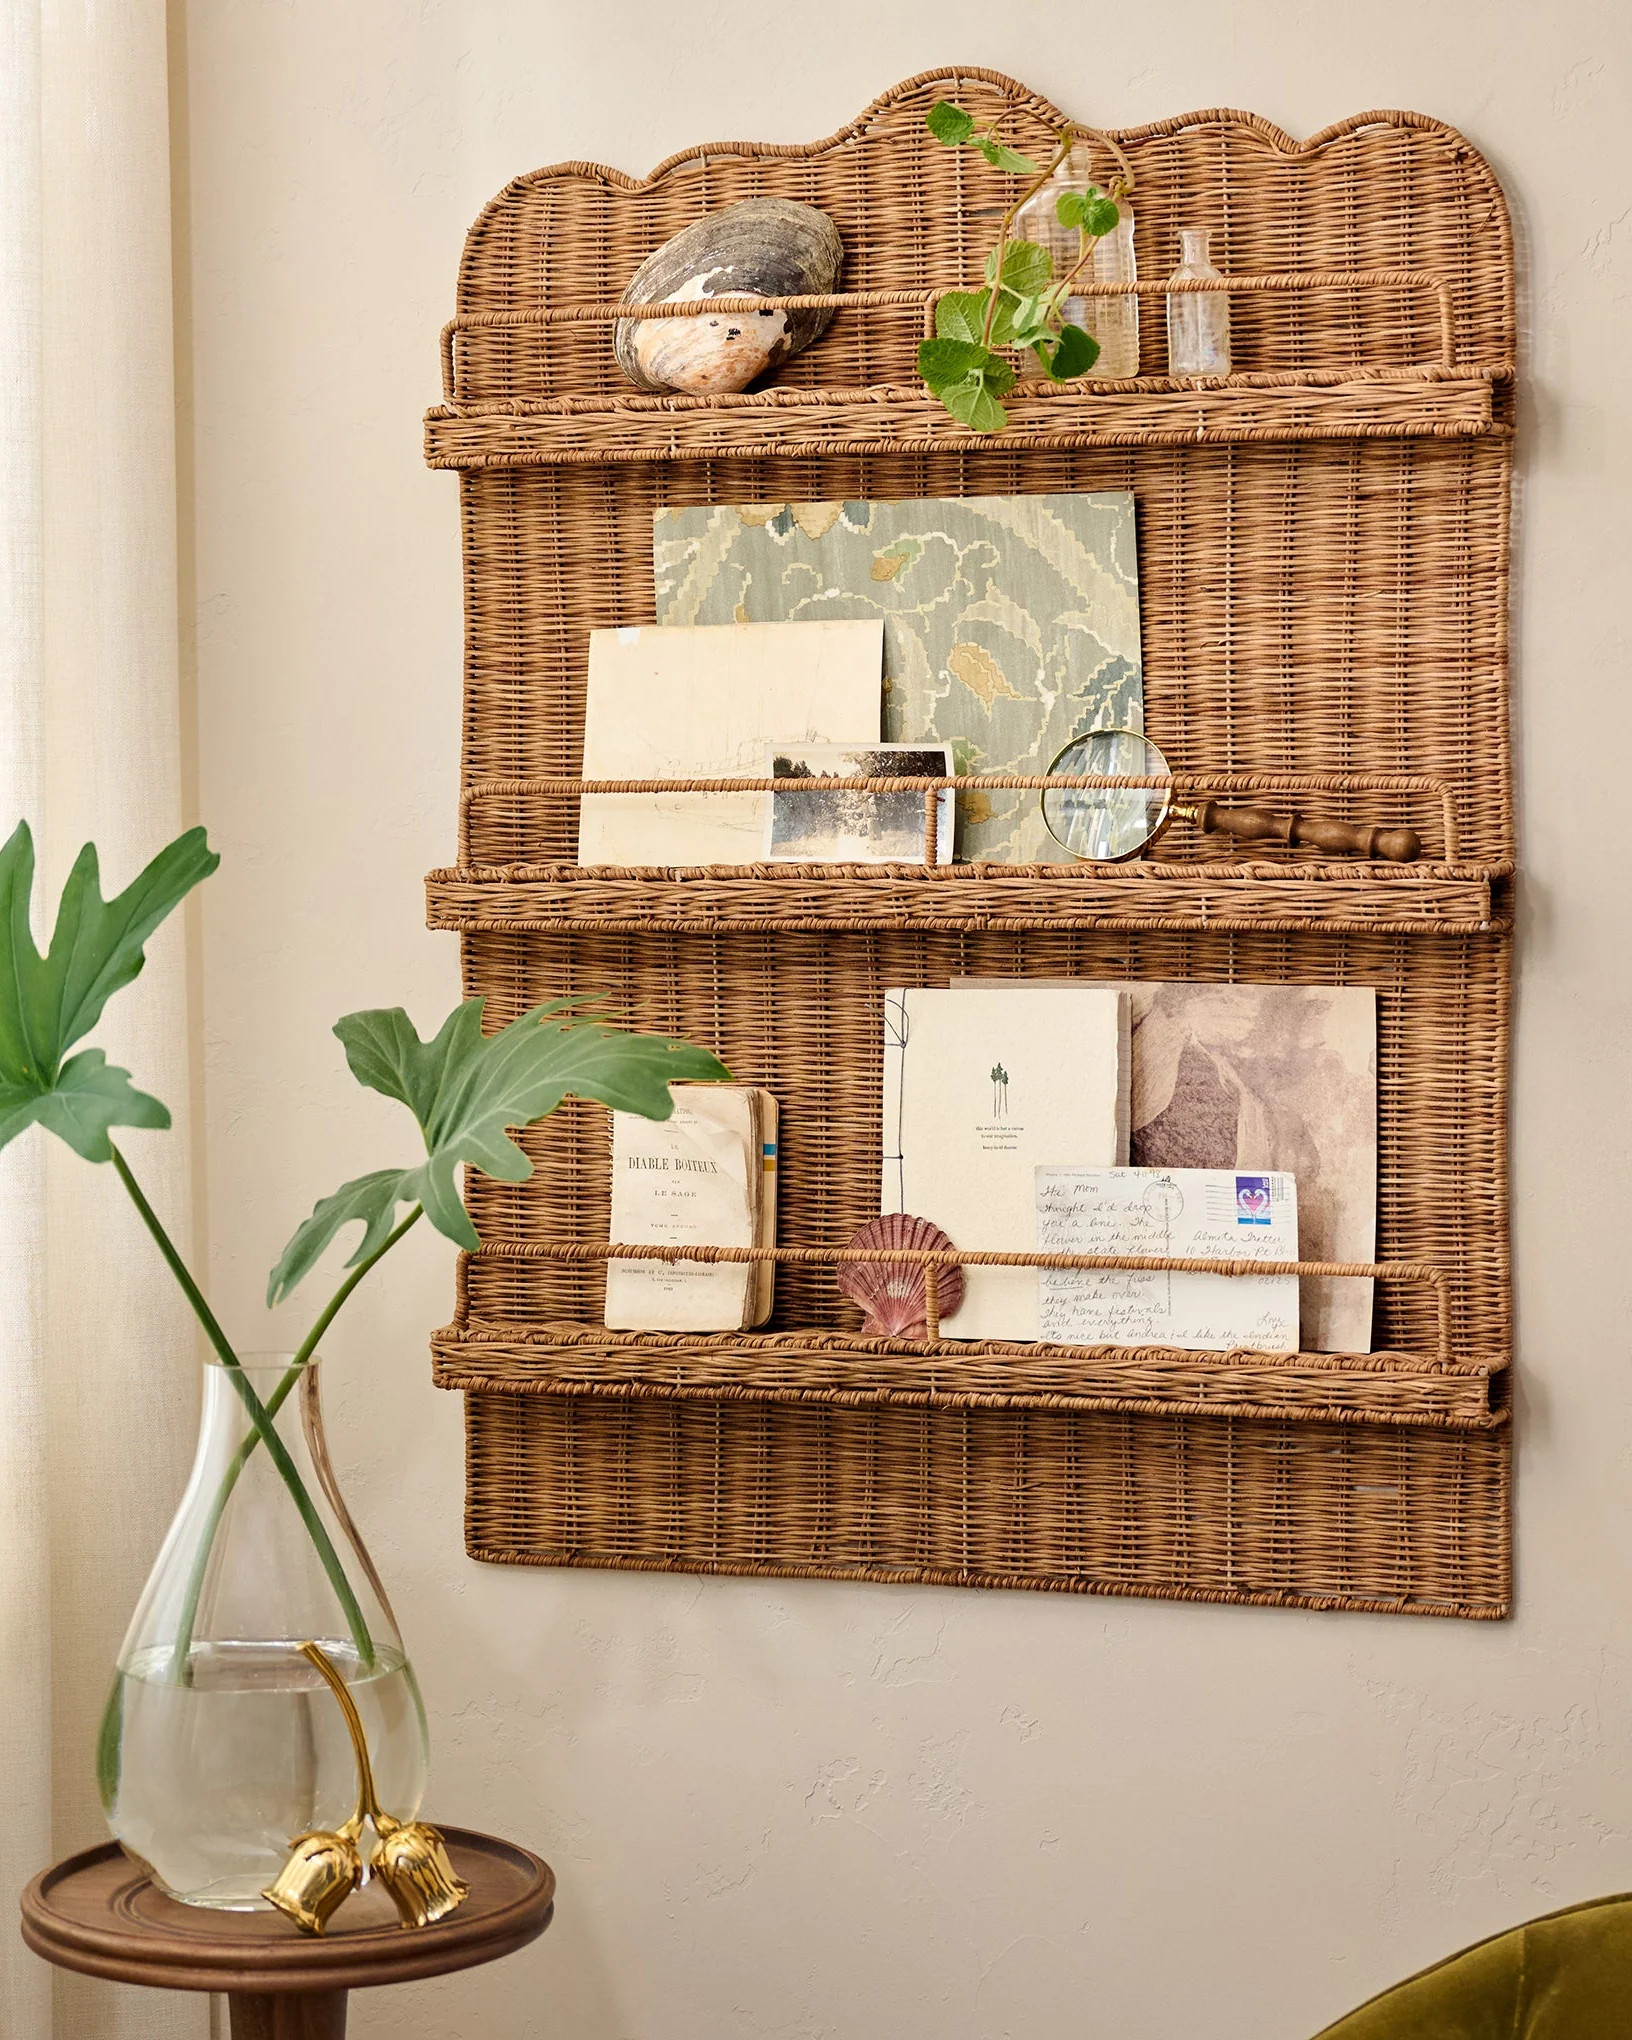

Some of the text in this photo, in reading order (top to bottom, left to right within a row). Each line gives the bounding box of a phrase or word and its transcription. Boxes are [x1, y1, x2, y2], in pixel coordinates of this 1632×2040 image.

[628, 1157, 718, 1174] DIABLE BOITEUX
[671, 1190, 697, 1198] SAGE
[1123, 1201, 1153, 1216] drop
[1072, 1220, 1083, 1228] a
[1108, 1231, 1128, 1243] the
[1131, 1230, 1176, 1242] middle
[1098, 1274, 1120, 1285] the
[1073, 1289, 1106, 1302] make
[1072, 1306, 1103, 1317] have
[1067, 1333, 1094, 1341] nice
[1099, 1330, 1120, 1340] but
